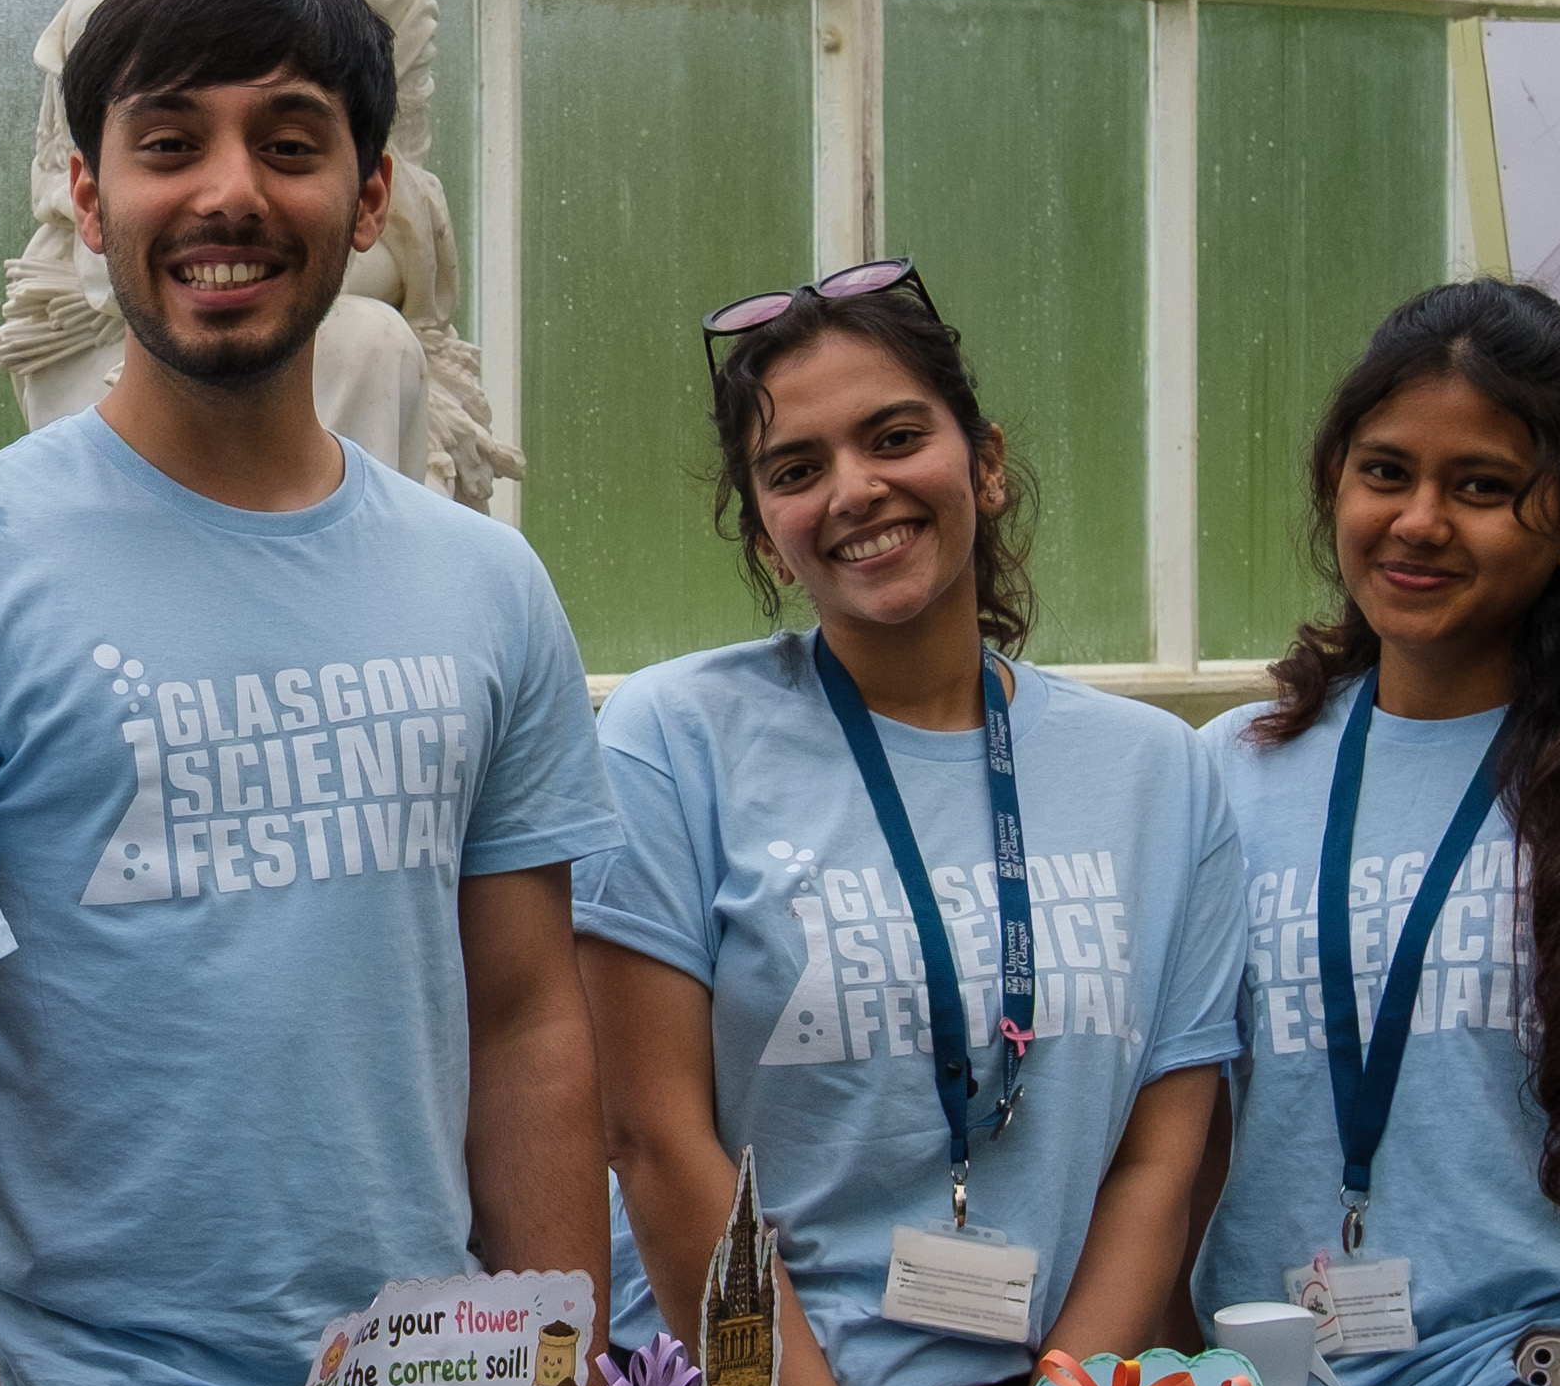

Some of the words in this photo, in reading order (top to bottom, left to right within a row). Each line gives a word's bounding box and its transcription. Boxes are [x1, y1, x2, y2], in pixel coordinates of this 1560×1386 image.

[156, 655, 460, 747] GLASGOW
[166, 714, 467, 817] SCIENCE
[173, 800, 458, 898] FESTIVAL
[1247, 841, 1531, 928] GLSGW
[1005, 919, 1018, 974] University
[1017, 920, 1030, 965] Glasgow
[388, 1310, 447, 1348] your
[454, 1299, 530, 1335] flower
[485, 1345, 529, 1380] soil!
